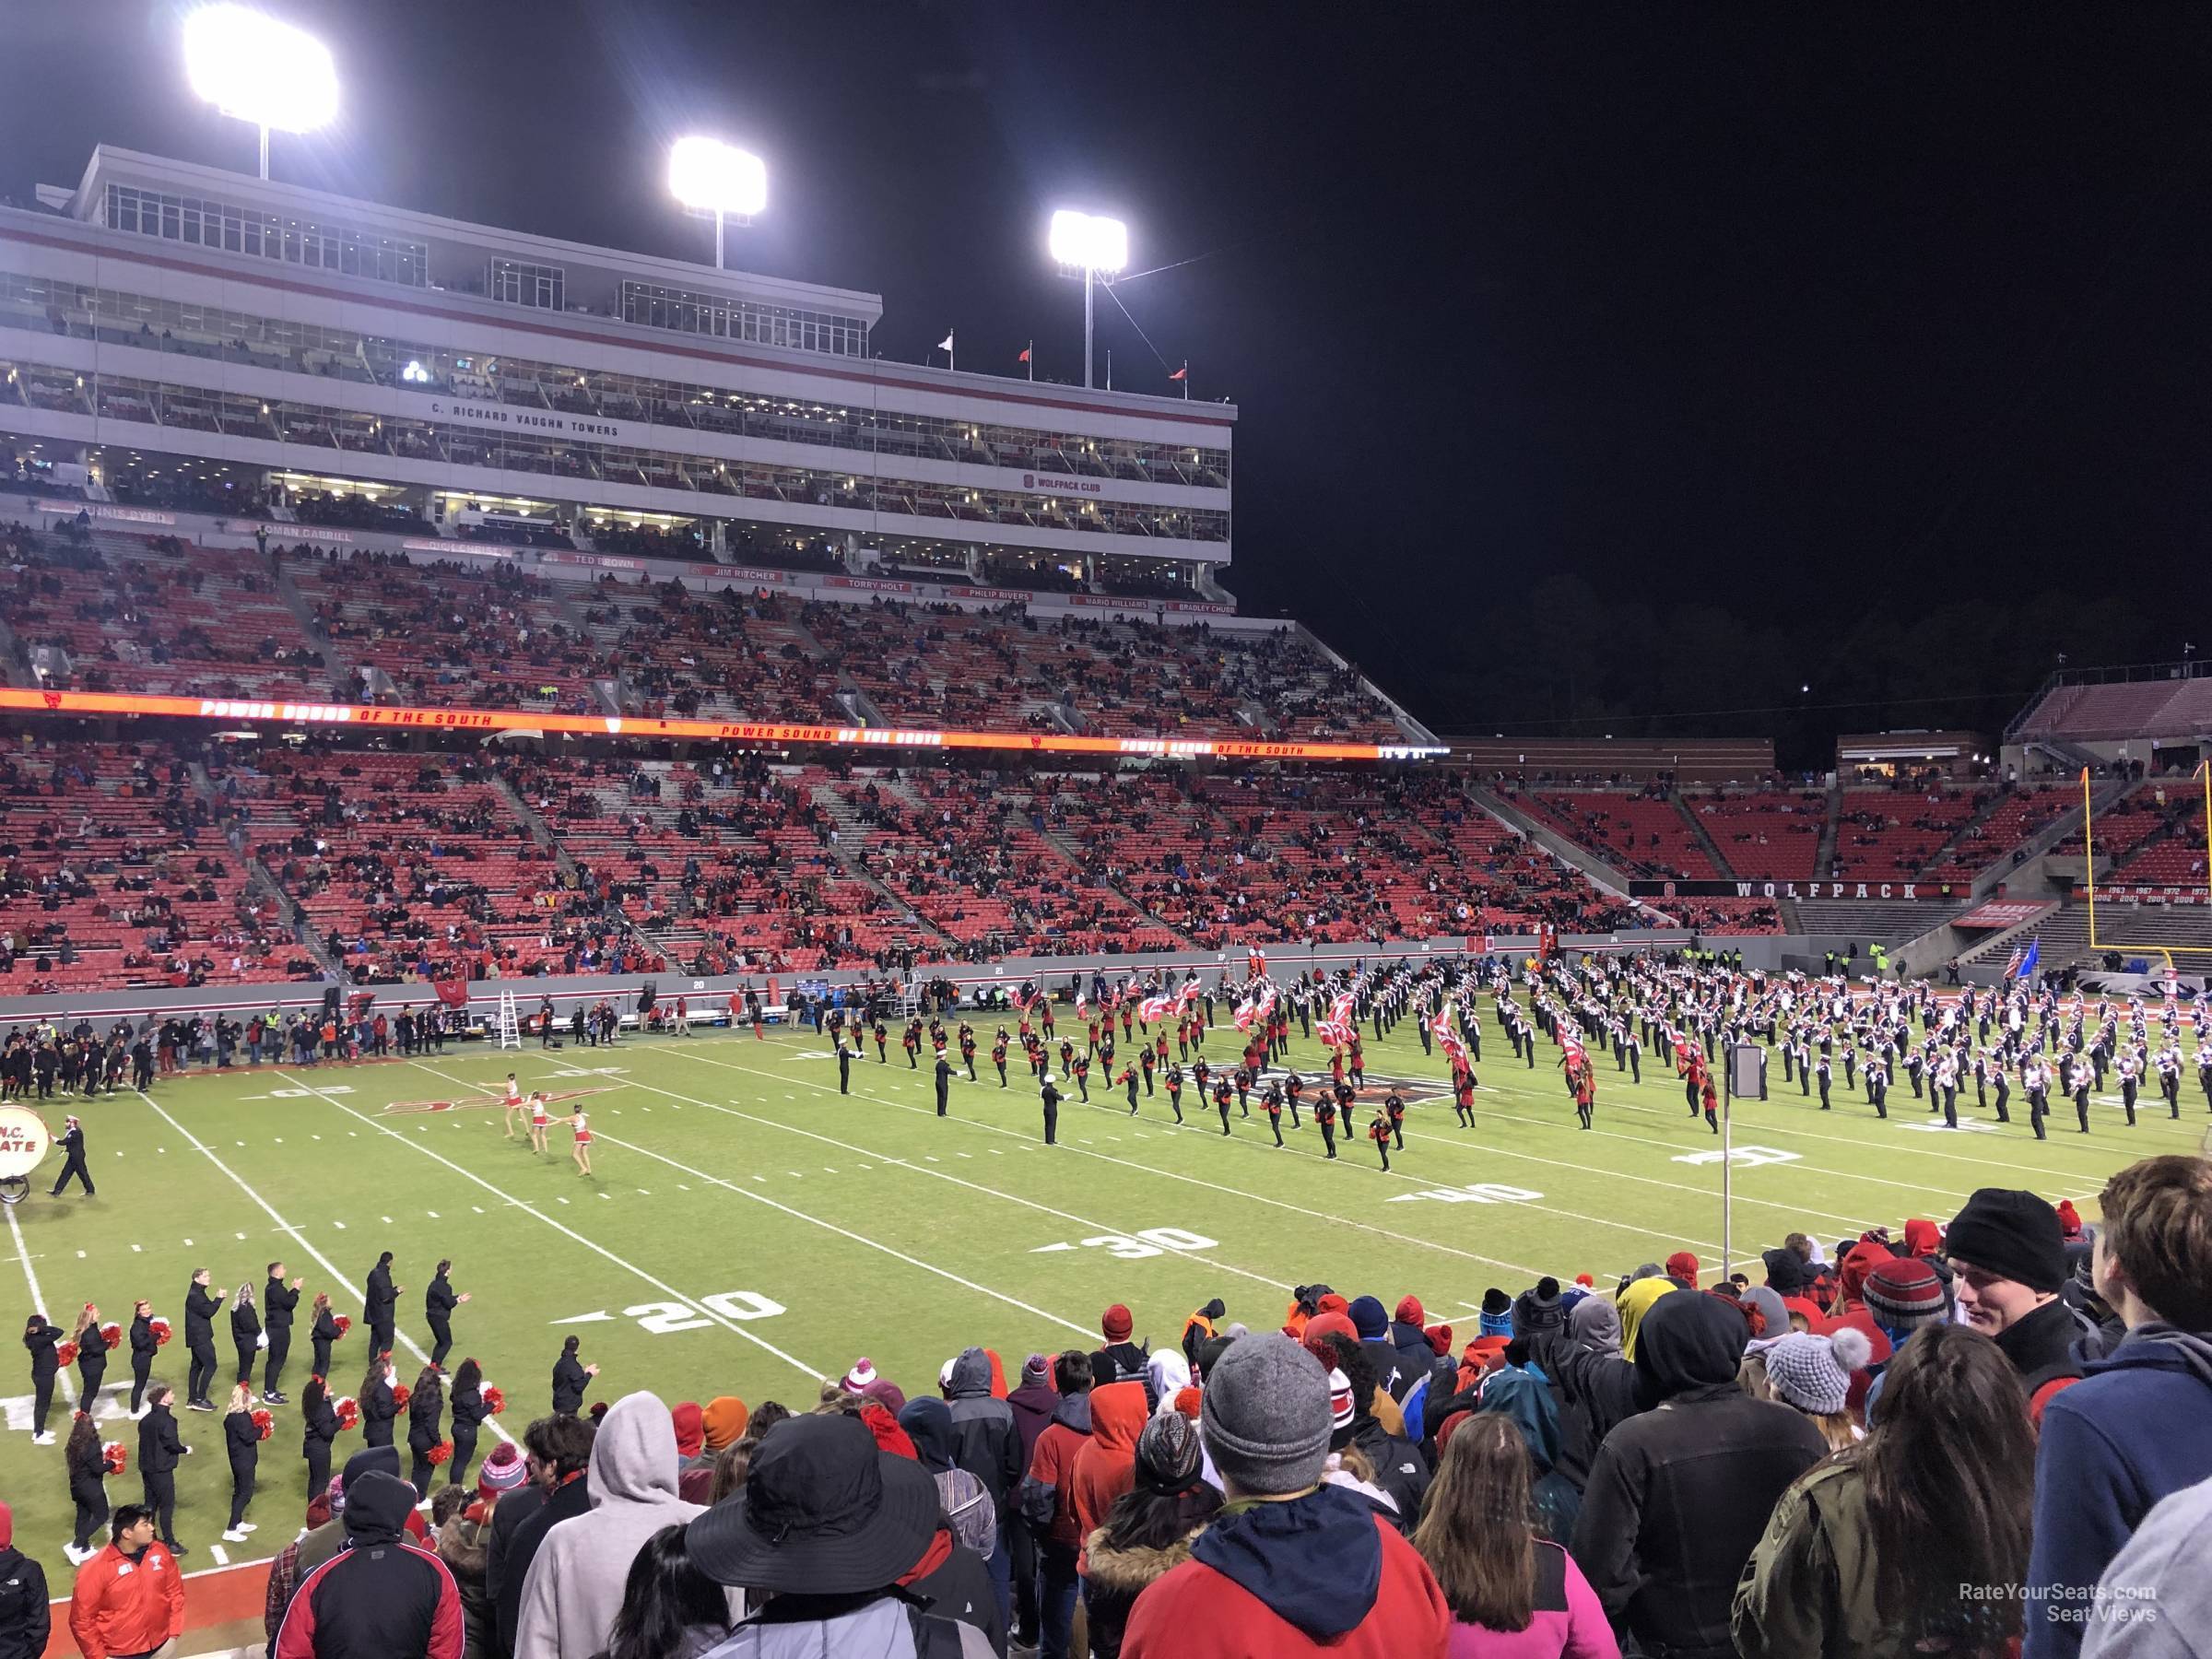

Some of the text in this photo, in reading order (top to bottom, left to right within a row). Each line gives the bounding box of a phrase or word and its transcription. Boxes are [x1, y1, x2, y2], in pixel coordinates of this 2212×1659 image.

[432, 403, 618, 436] C. RICHARD VAUGHN TOWERS
[1038, 478, 1078, 490] WOLFPACK
[1081, 483, 1100, 492] CLUB
[257, 524, 353, 542] OMAN GABRIEL
[574, 555, 635, 568] TED BROWN
[714, 568, 776, 581] JIM RITCHER
[849, 580, 904, 592] TORRY HOLT
[970, 589, 1030, 601] PHILIP RIVERS
[1085, 597, 1147, 609] MARIO WILLIAMS
[1179, 603, 1209, 613] BRADLEY
[360, 711, 382, 721] OF
[393, 712, 425, 723] THE
[435, 713, 492, 725] SOUTH
[722, 726, 774, 737] POWER
[782, 729, 832, 739] SOUND
[1218, 745, 1231, 754] OF
[1239, 746, 1259, 754] THE
[1266, 747, 1304, 755] SOUTH
[1736, 882, 1917, 900] WOLFPACK
[2192, 888, 2208, 896] 1973
[2147, 895, 2166, 903] 2005
[995, 967, 1004, 975] 21
[693, 981, 705, 990] 20
[1415, 1182, 1546, 1205] 40
[1080, 1227, 1219, 1259] 30
[621, 1290, 788, 1335] 20
